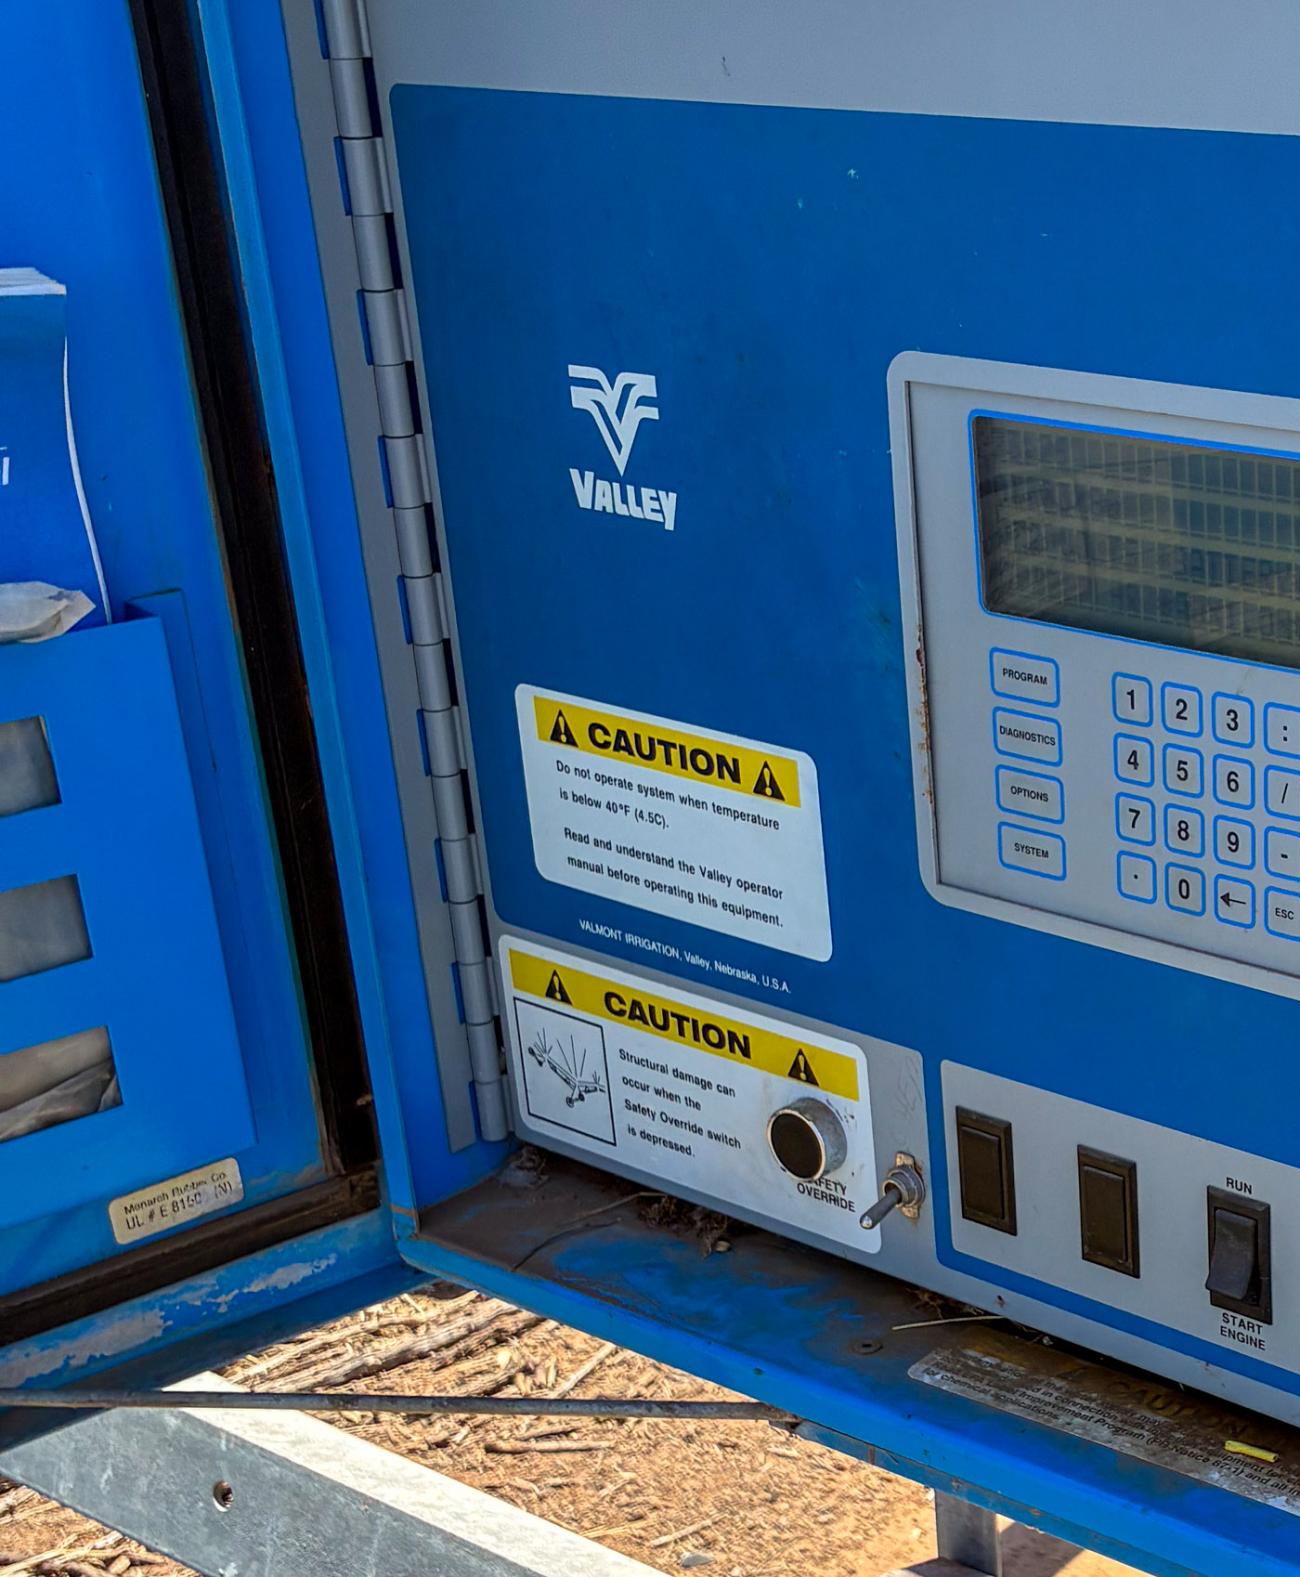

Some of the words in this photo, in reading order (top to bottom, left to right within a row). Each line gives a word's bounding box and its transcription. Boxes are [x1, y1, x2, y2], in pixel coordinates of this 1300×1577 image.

[569, 468, 678, 532] VALLEY
[1002, 668, 1048, 686] PROGRAM
[1126, 689, 1136, 710] 1
[1175, 699, 1189, 721] 2
[1226, 709, 1239, 732] 3
[999, 725, 1057, 747] DIAGNOSTICS
[587, 722, 742, 785] CAUTION
[1127, 750, 1140, 770] 4
[1176, 760, 1189, 782] 5
[1226, 771, 1240, 793] 6
[556, 760, 571, 774] Do
[574, 764, 591, 780] not
[594, 772, 634, 792] operate
[637, 782, 676, 803] system
[679, 793, 708, 811] when
[711, 802, 781, 831] temperature
[1010, 785, 1049, 803] OPTIONS
[559, 787, 569, 800] is
[571, 790, 602, 809] below
[605, 800, 631, 818] 40°F
[634, 807, 670, 829] (4.5C).
[1128, 809, 1141, 830] 7
[1177, 820, 1190, 842] 8
[1226, 832, 1240, 853] 9
[1014, 842, 1050, 859] SYSTEM
[564, 827, 590, 845] Read
[593, 836, 612, 852] and
[615, 840, 675, 869] understand
[678, 858, 696, 876] the
[699, 865, 733, 888] Valley
[736, 877, 783, 901] operator
[567, 856, 604, 875] manual
[607, 865, 641, 886] before
[644, 878, 694, 904] operating
[697, 891, 718, 909] this
[721, 900, 784, 928] equipment.
[1178, 879, 1191, 900] 0
[1275, 907, 1295, 921] ESC
[579, 919, 622, 942] VALMONT
[625, 933, 683, 961] IRRIGATION,
[684, 951, 713, 971] Valley,
[714, 961, 760, 985] Nebraska,
[762, 974, 791, 994] U.S.A.
[604, 991, 752, 1059] CAUTION
[619, 1048, 669, 1075] Structural
[672, 1068, 713, 1090] damage
[716, 1084, 736, 1098] can
[622, 1076, 650, 1093] occur
[654, 1086, 681, 1104] when
[684, 1096, 701, 1111] the
[625, 1099, 656, 1121] Safety
[660, 1111, 704, 1136] Override
[707, 1130, 742, 1150] switch
[628, 1124, 637, 1137] is
[640, 1128, 696, 1158] depressed.
[808, 1176, 847, 1196] AFETY
[1226, 1177, 1252, 1194] RUN
[123, 1192, 169, 1215] Monarch
[797, 1182, 856, 1213] OVERRIDE
[126, 1217, 145, 1230] UL
[1222, 1312, 1263, 1335] START
[1220, 1326, 1266, 1351] ENGINE
[938, 1372, 993, 1395] chemical
[1052, 1394, 1120, 1421] connection
[1015, 1390, 1096, 1422] Improvement
[1091, 1416, 1149, 1441] Program
[1243, 1470, 1272, 1484] and
[1269, 1480, 1289, 1490] all
